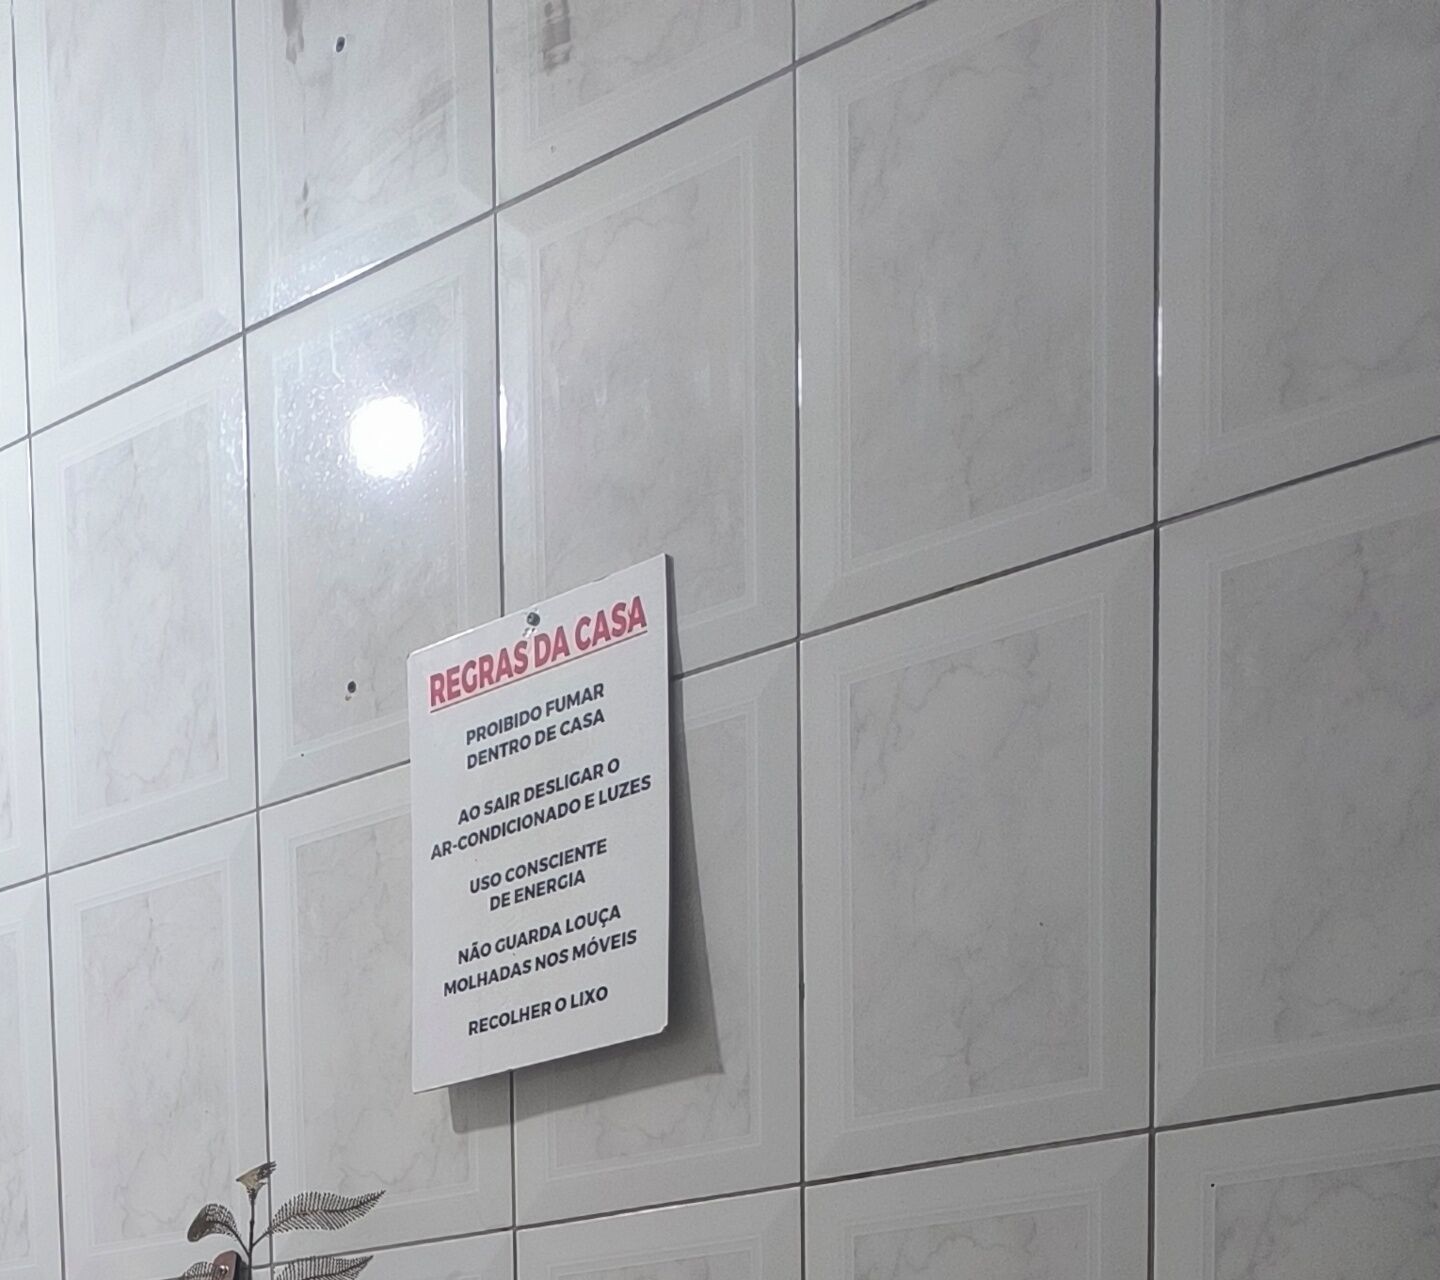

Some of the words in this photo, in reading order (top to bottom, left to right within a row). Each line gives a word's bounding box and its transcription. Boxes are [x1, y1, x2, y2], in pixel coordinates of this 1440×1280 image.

[429, 640, 528, 707] REGRAS
[533, 625, 570, 668] DA
[574, 595, 648, 650] CASA
[466, 706, 542, 746] PROIBIDO
[545, 683, 605, 717] FUMAR
[466, 735, 531, 770] DENTRO
[534, 724, 557, 746] DE
[560, 708, 606, 736] CASA
[430, 797, 581, 861] AR-CONDICIONADO
[584, 793, 596, 810] E
[598, 774, 652, 806] LUZES
[458, 804, 481, 825] AO
[483, 791, 521, 816] SAIR
[524, 762, 604, 803] DESLIGAR
[607, 757, 621, 774] O
[470, 872, 502, 894] USO
[504, 838, 608, 883] CONSCIENTE
[489, 891, 511, 911] DE
[514, 869, 586, 904] ENERGIA
[443, 958, 532, 997] MOLHADAS
[534, 948, 569, 972] NOS
[572, 929, 638, 962] MÓVEIS
[458, 941, 492, 965] NÃO
[494, 921, 563, 954] GUARDA
[565, 904, 622, 934] LOUÇA
[468, 1000, 551, 1036] RECOLHER
[554, 996, 567, 1013] O
[570, 986, 608, 1009] LIXO
